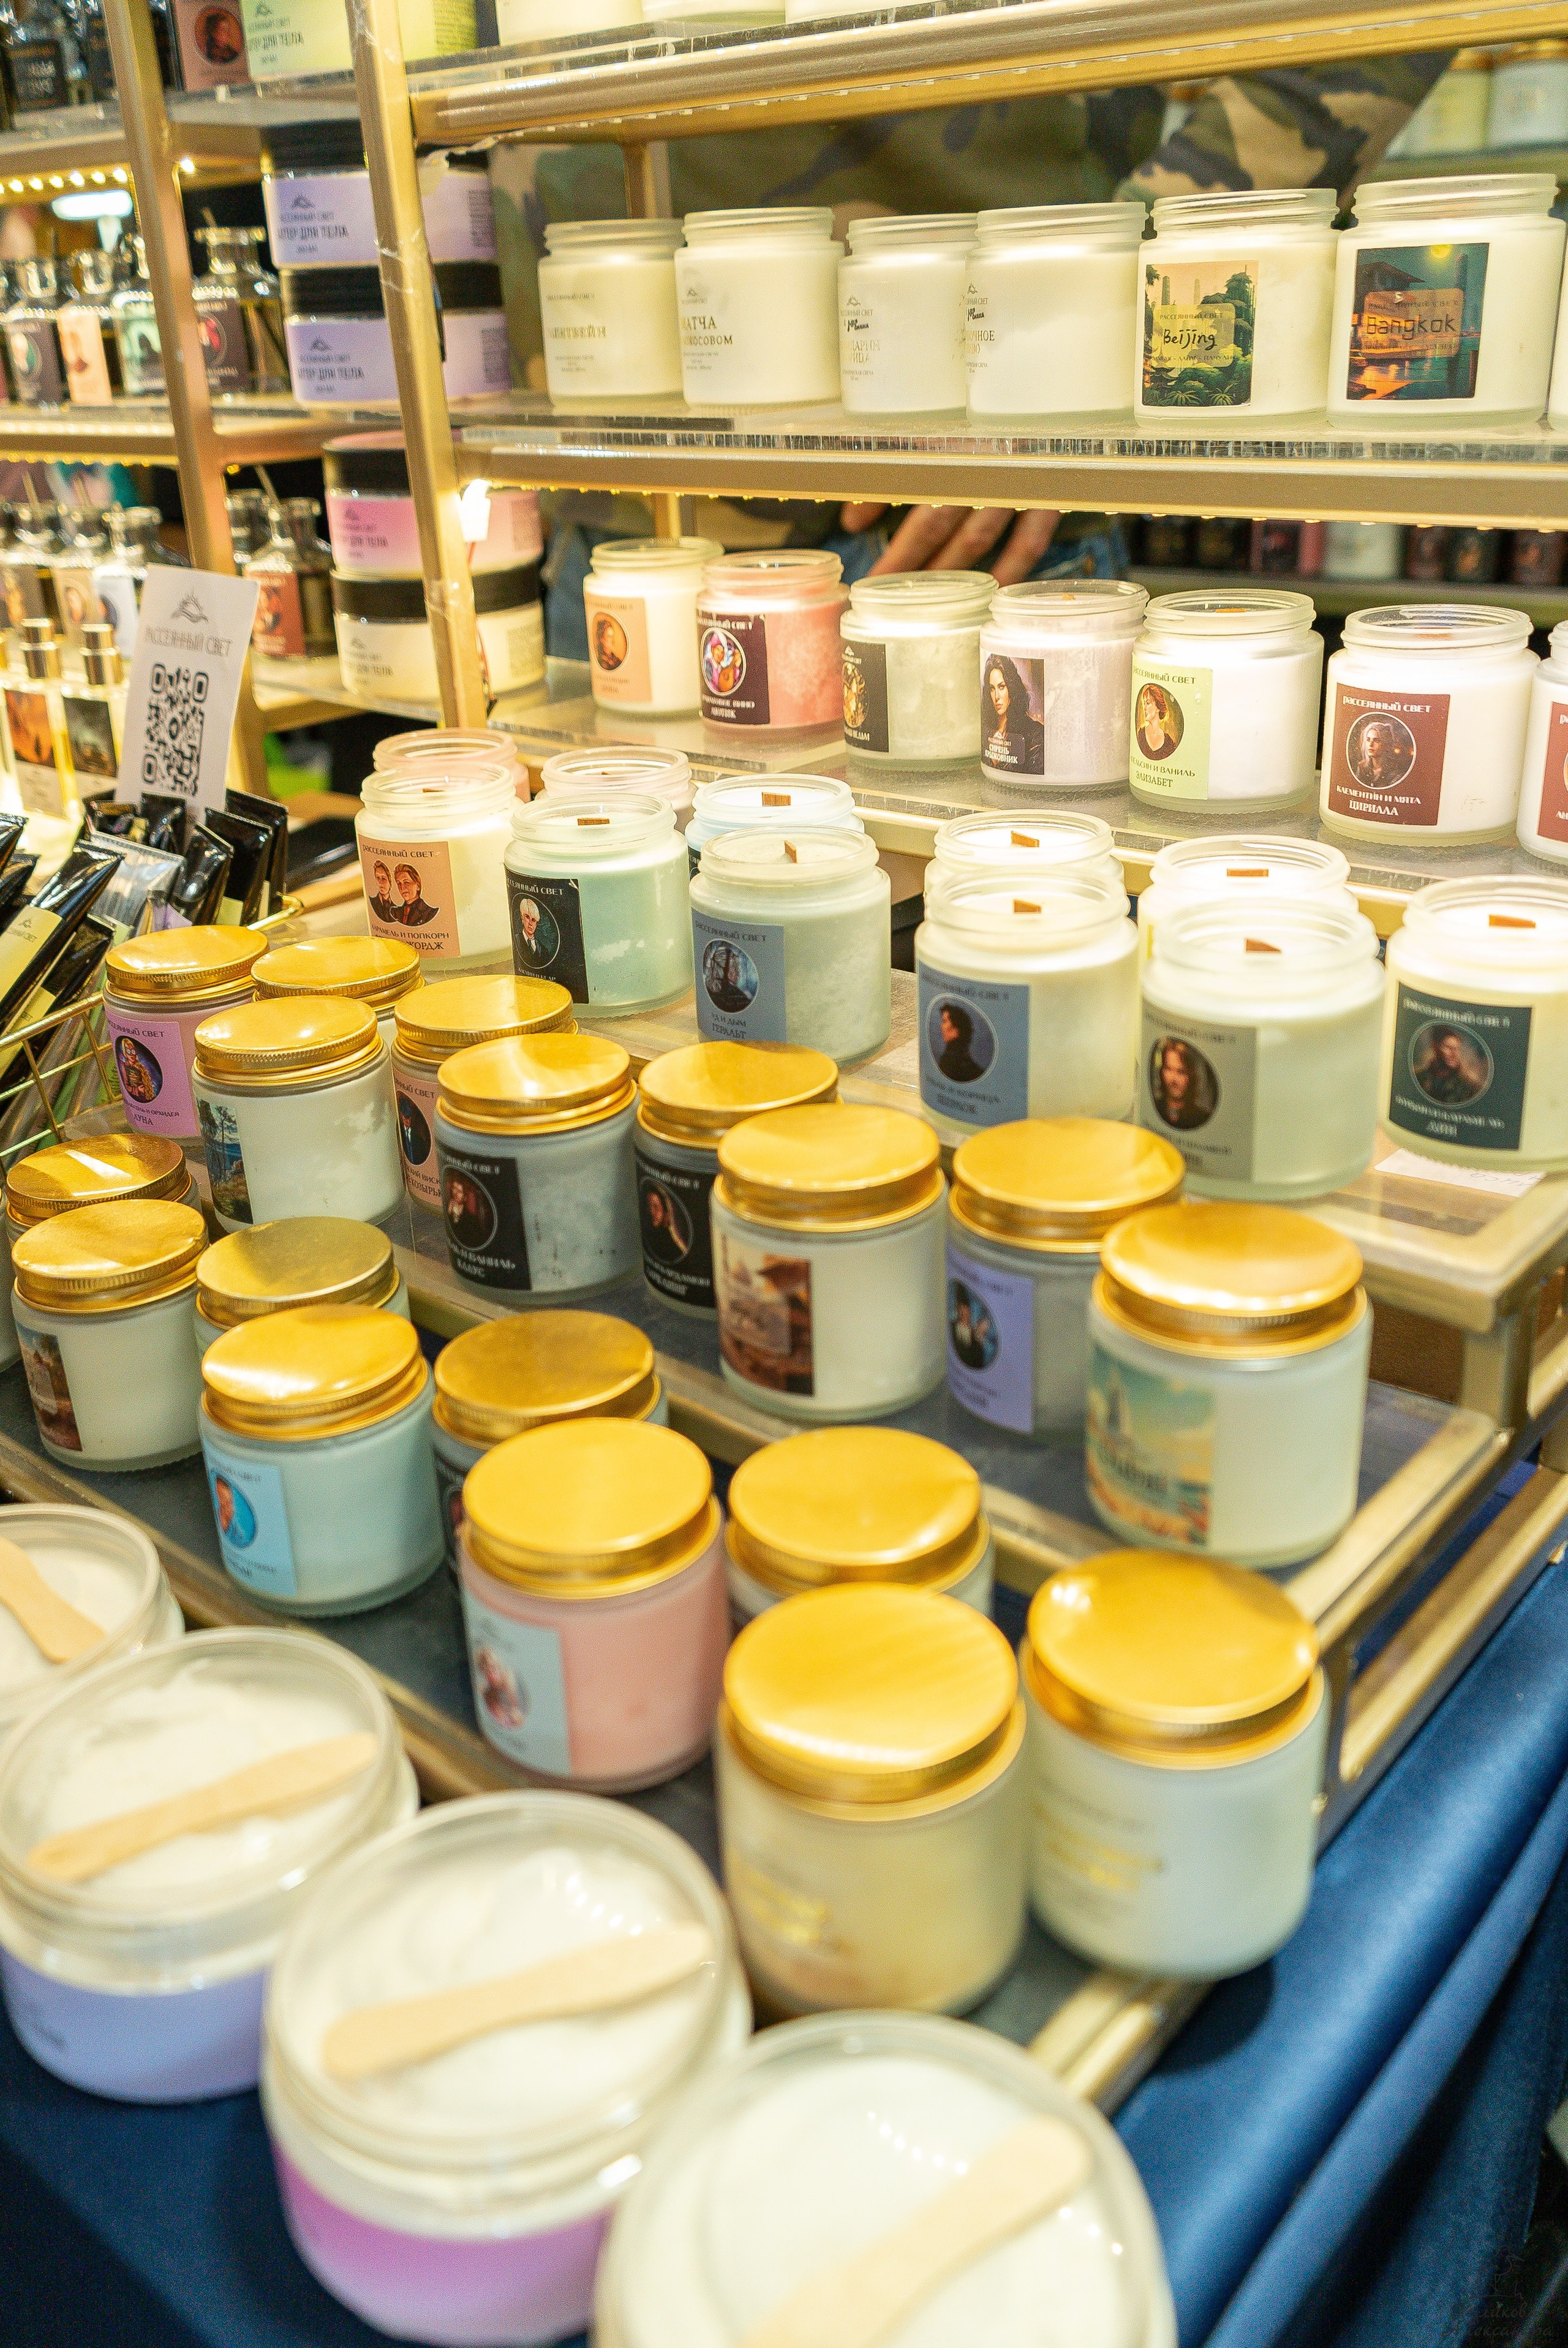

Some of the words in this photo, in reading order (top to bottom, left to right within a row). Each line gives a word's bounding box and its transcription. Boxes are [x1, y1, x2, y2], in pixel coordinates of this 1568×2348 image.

[1366, 313, 1457, 341] Bangkok
[1172, 676, 1196, 684] СВЕТ
[1403, 704, 1432, 713] СВЕТ
[989, 743, 1010, 755] СИРЕНЬ
[1160, 766, 1196, 777] ВАНИЛЬ
[1136, 770, 1173, 788] ЭЛИЗАБЕТ
[1336, 785, 1383, 801] КЛЕМЕНТИН
[1393, 795, 1422, 805] МЯТА
[1349, 799, 1399, 816] ЦИРИЛЛА
[540, 886, 564, 896] СВЕТ
[741, 933, 766, 942] СВЕТ
[406, 942, 445, 951] ЖОРДЖ
[712, 1022, 747, 1039] ГЕРАЛЬТ
[414, 1088, 435, 1099] СВЕТ
[421, 1174, 441, 1185] ВИСК
